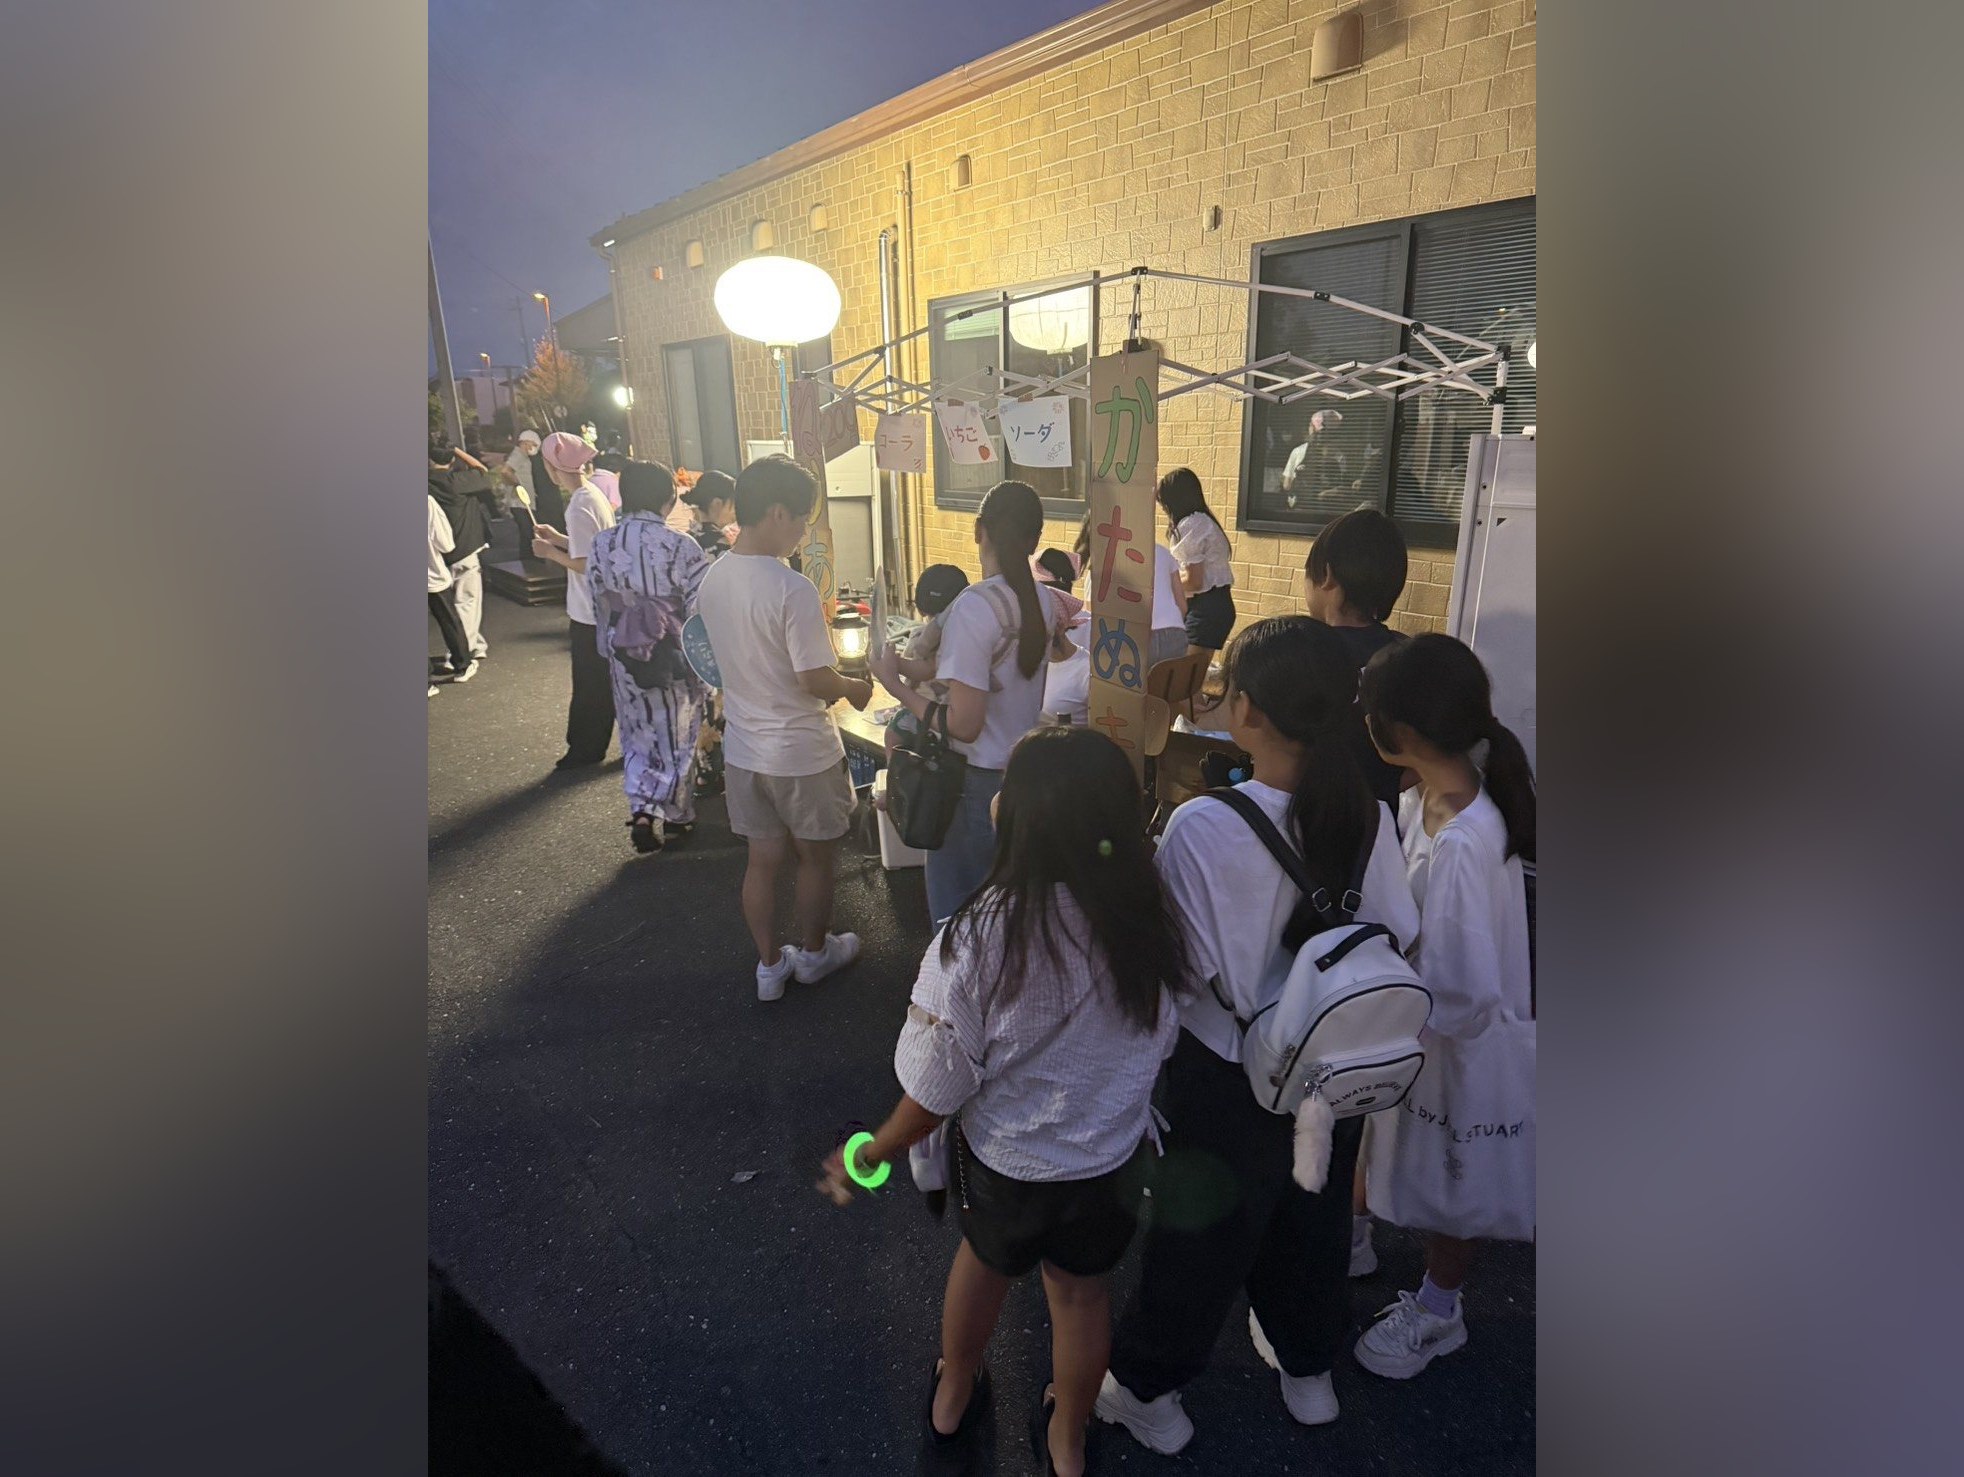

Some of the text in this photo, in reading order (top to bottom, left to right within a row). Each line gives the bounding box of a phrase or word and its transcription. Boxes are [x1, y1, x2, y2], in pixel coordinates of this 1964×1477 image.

[945, 424, 978, 443] いちご
[1010, 421, 1055, 443] ソーダ
[879, 434, 913, 452] コーラ
[1328, 1084, 1372, 1107] ALWAYS
